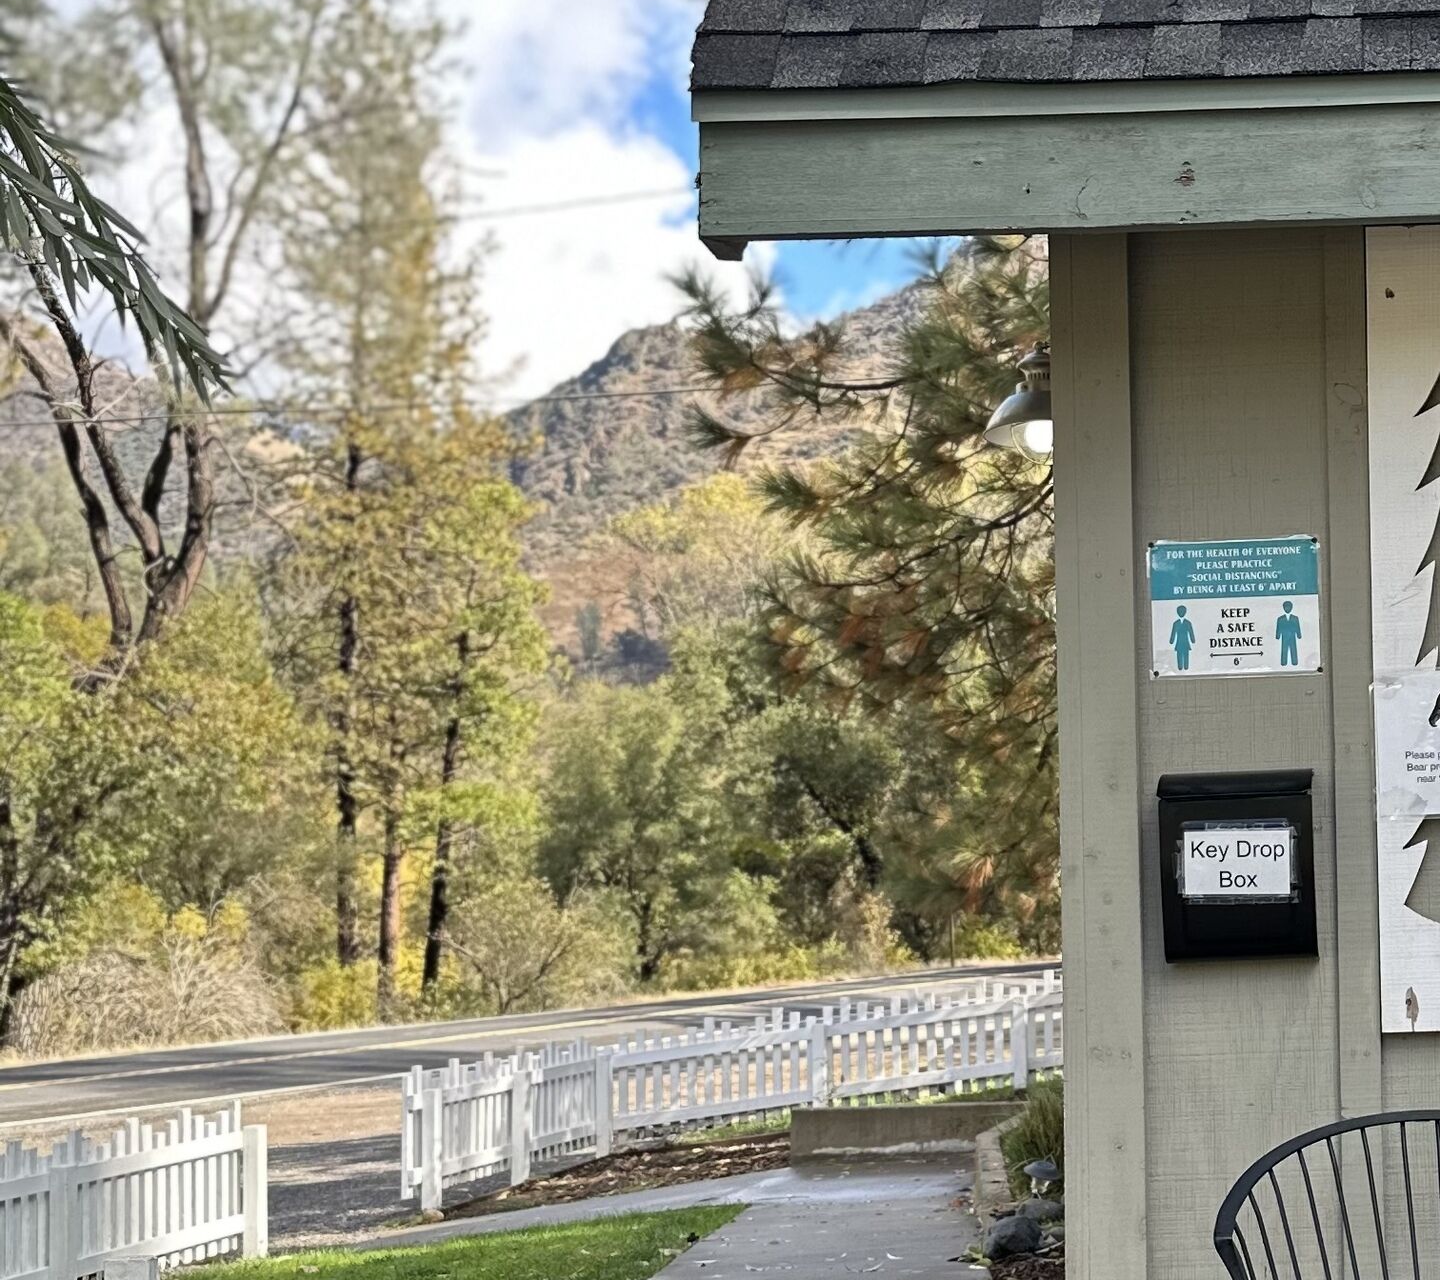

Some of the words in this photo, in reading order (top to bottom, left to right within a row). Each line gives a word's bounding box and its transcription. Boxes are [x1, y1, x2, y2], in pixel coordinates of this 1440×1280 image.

[1166, 550, 1185, 559] FOR
[1187, 550, 1204, 558] THE
[1206, 548, 1240, 558] HEALTH
[1242, 547, 1254, 557] OF
[1257, 546, 1301, 556] EVERYONE
[1196, 560, 1229, 570] PLEASE
[1231, 559, 1273, 568] PRACTICE
[1173, 586, 1185, 595] BY
[1187, 584, 1214, 594] BEING
[1216, 584, 1227, 593] AT
[1230, 583, 1256, 592] LEAST
[1269, 581, 1297, 591] APART
[1221, 608, 1250, 619] KEEP
[1217, 623, 1224, 633] A
[1227, 622, 1255, 633] SAFE
[1209, 636, 1263, 649] DISTANCE
[1405, 750, 1435, 760] Please
[1406, 762, 1427, 771] Bear
[1416, 775, 1437, 783] near
[1191, 840, 1229, 862] Key
[1236, 840, 1286, 861] Drop
[1219, 870, 1258, 888] Box
